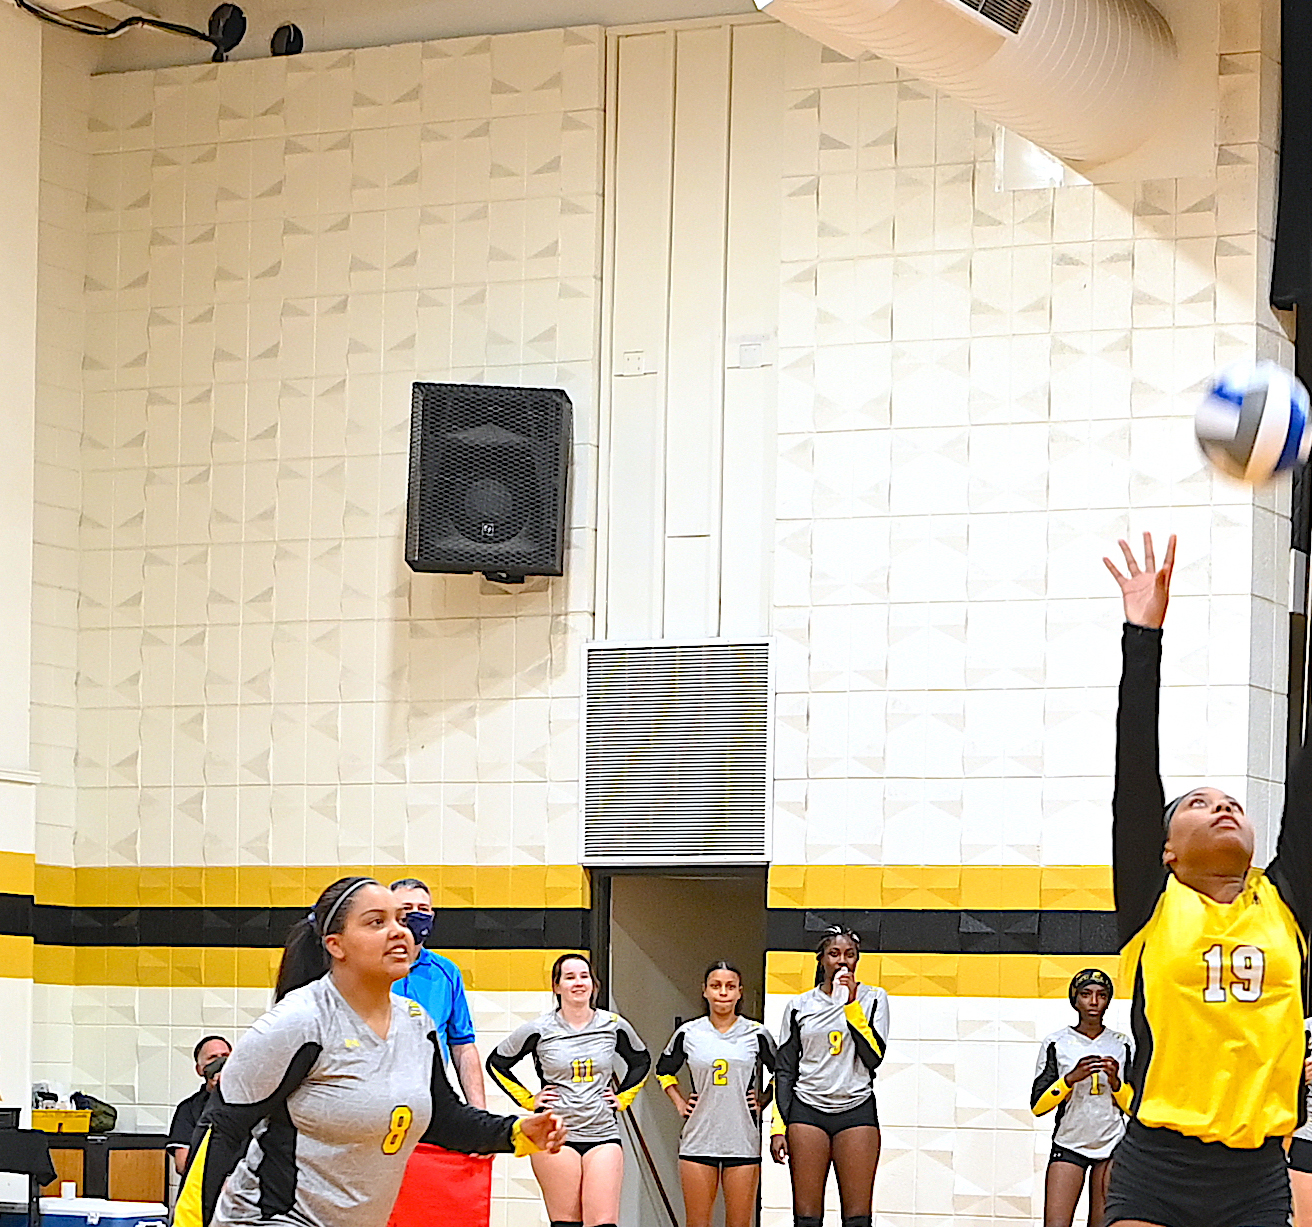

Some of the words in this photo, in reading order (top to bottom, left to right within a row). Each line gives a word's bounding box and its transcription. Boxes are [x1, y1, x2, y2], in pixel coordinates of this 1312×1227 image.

[1202, 943, 1266, 1002] 19
[828, 1030, 843, 1056] 9
[570, 1059, 594, 1083] 11
[713, 1059, 728, 1086] 2
[381, 1105, 413, 1155] 8
